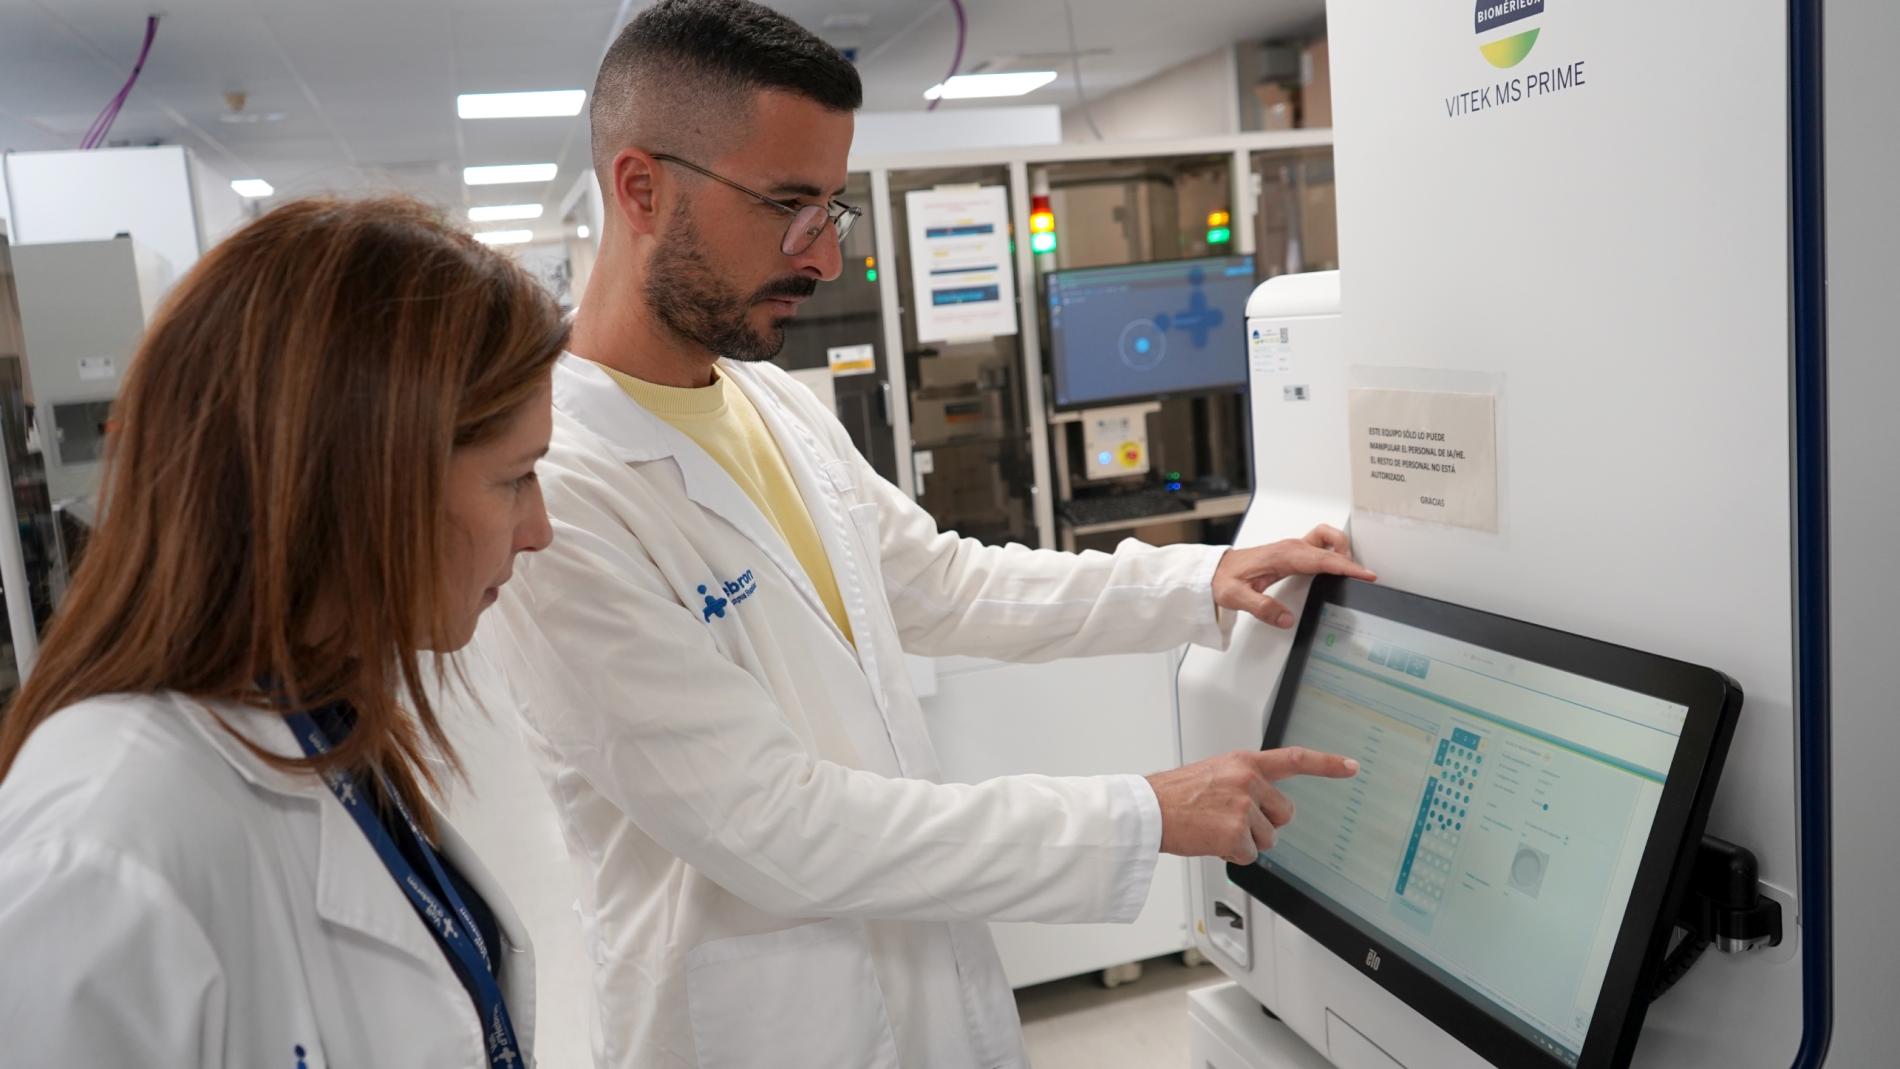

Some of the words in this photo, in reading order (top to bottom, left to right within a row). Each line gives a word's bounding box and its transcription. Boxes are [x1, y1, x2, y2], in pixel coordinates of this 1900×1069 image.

[1477, 0, 1541, 24] BIOMÉRIEU
[1445, 86, 1492, 118] VITEK
[1496, 78, 1522, 106] MS
[1527, 61, 1586, 98] PRIME
[1368, 427, 1381, 436] ESTE
[1382, 428, 1402, 438] EQUIPO
[1403, 429, 1417, 439] SÓLO
[1418, 431, 1425, 440] LO
[1426, 432, 1445, 442] PUEDE
[1369, 442, 1401, 453] MANIPULAR
[1402, 445, 1408, 453] EL
[1408, 446, 1437, 456] PERSONAL
[1438, 449, 1446, 457] DE
[1370, 456, 1377, 464] EL
[1377, 457, 1394, 466] RESTO
[1394, 458, 1401, 467] DE
[1402, 459, 1431, 470] PERSONAL
[1431, 463, 1441, 472] NO
[1441, 463, 1456, 473] ESTÁ
[1370, 471, 1406, 482] AUTORIZADO.
[1420, 496, 1445, 507] GRACIAS
